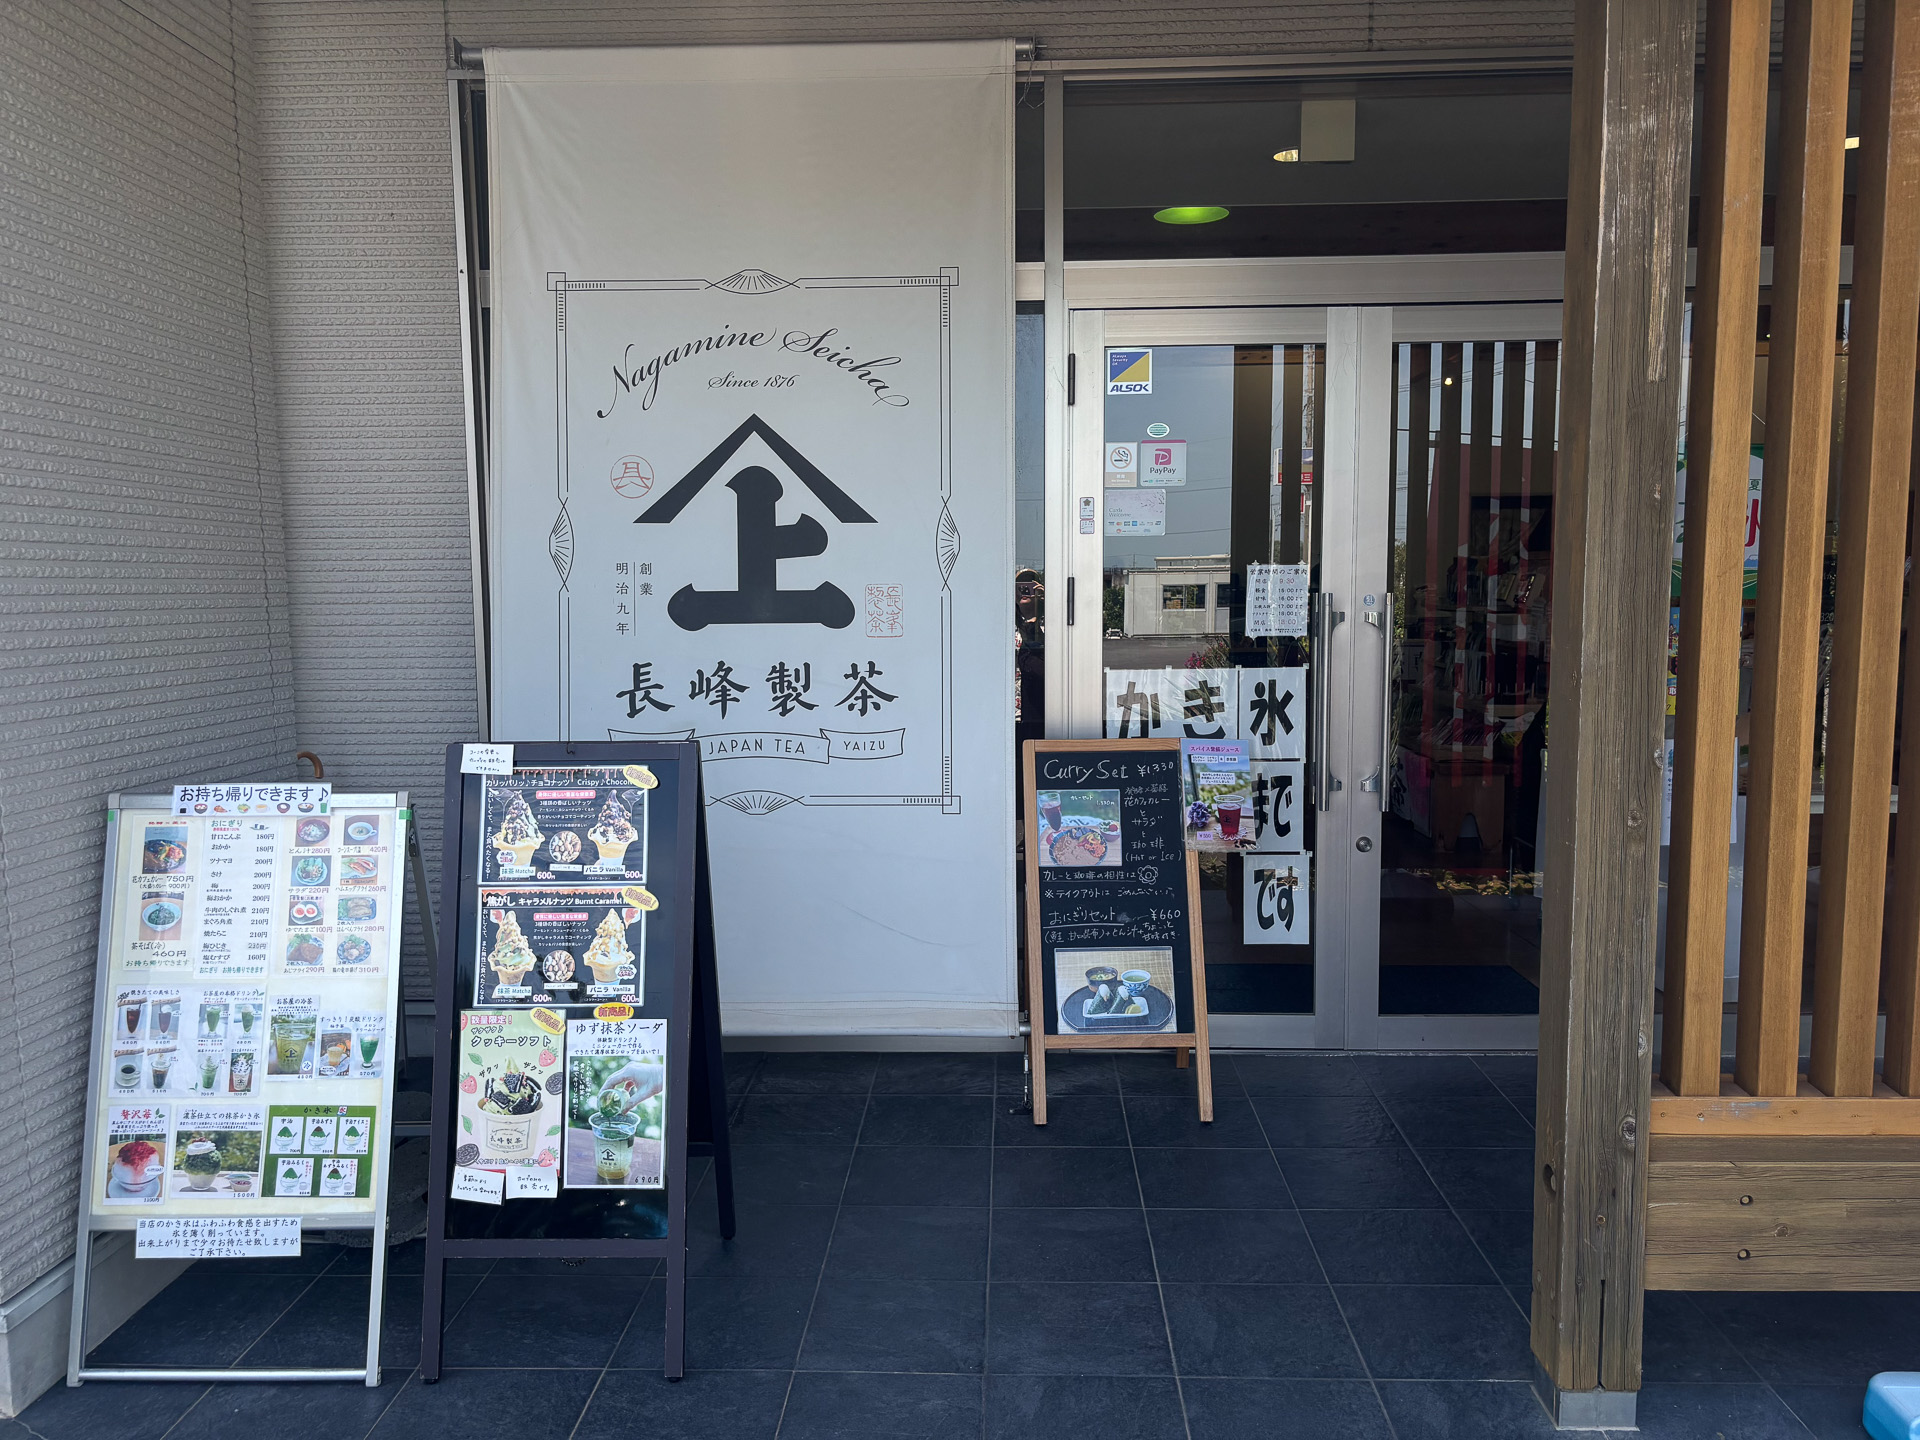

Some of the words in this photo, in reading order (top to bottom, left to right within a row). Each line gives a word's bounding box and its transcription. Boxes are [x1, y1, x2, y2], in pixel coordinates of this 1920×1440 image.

[597, 324, 777, 418] Nagamine
[778, 327, 909, 407] Seicha
[708, 371, 759, 390] Since
[763, 374, 801, 388] 1876
[1110, 384, 1149, 392] ALSOK
[640, 562, 653, 596] 創業
[616, 562, 630, 636] 明治九年
[616, 660, 899, 720] 長峰製茶
[1116, 679, 1294, 746] かき氷
[708, 738, 763, 755] JAPAN
[774, 738, 806, 754] TEA
[844, 740, 886, 751] YAIZU
[1044, 760, 1094, 784] Curry
[1096, 760, 1128, 779] Set
[577, 779, 598, 787] Crispy
[1132, 816, 1163, 826] サラダ
[1131, 836, 1164, 850] 珈琲
[1043, 870, 1136, 880] カレーと珈琲の相性は
[487, 896, 515, 906] 焦がし
[1254, 868, 1297, 932] です
[1048, 907, 1115, 925] おにぎりセット
[1150, 908, 1180, 921] ¥660
[598, 1007, 631, 1017] 新商品!
[471, 1015, 513, 1025] 数量限定!
[576, 1022, 663, 1035] ゆず抹茶ソーダ
[471, 1036, 552, 1047] クッキーソフト
[121, 1109, 152, 1120] 贅沢苺
[139, 1219, 298, 1228] 当店のかき氷はふわふわ食感を出すため
[172, 1229, 265, 1237] 氷を薄く削っています。
[138, 1238, 299, 1248] 出来上がりまで少々お待たせ致しますが
[190, 1248, 246, 1256] ご了承下さい。
